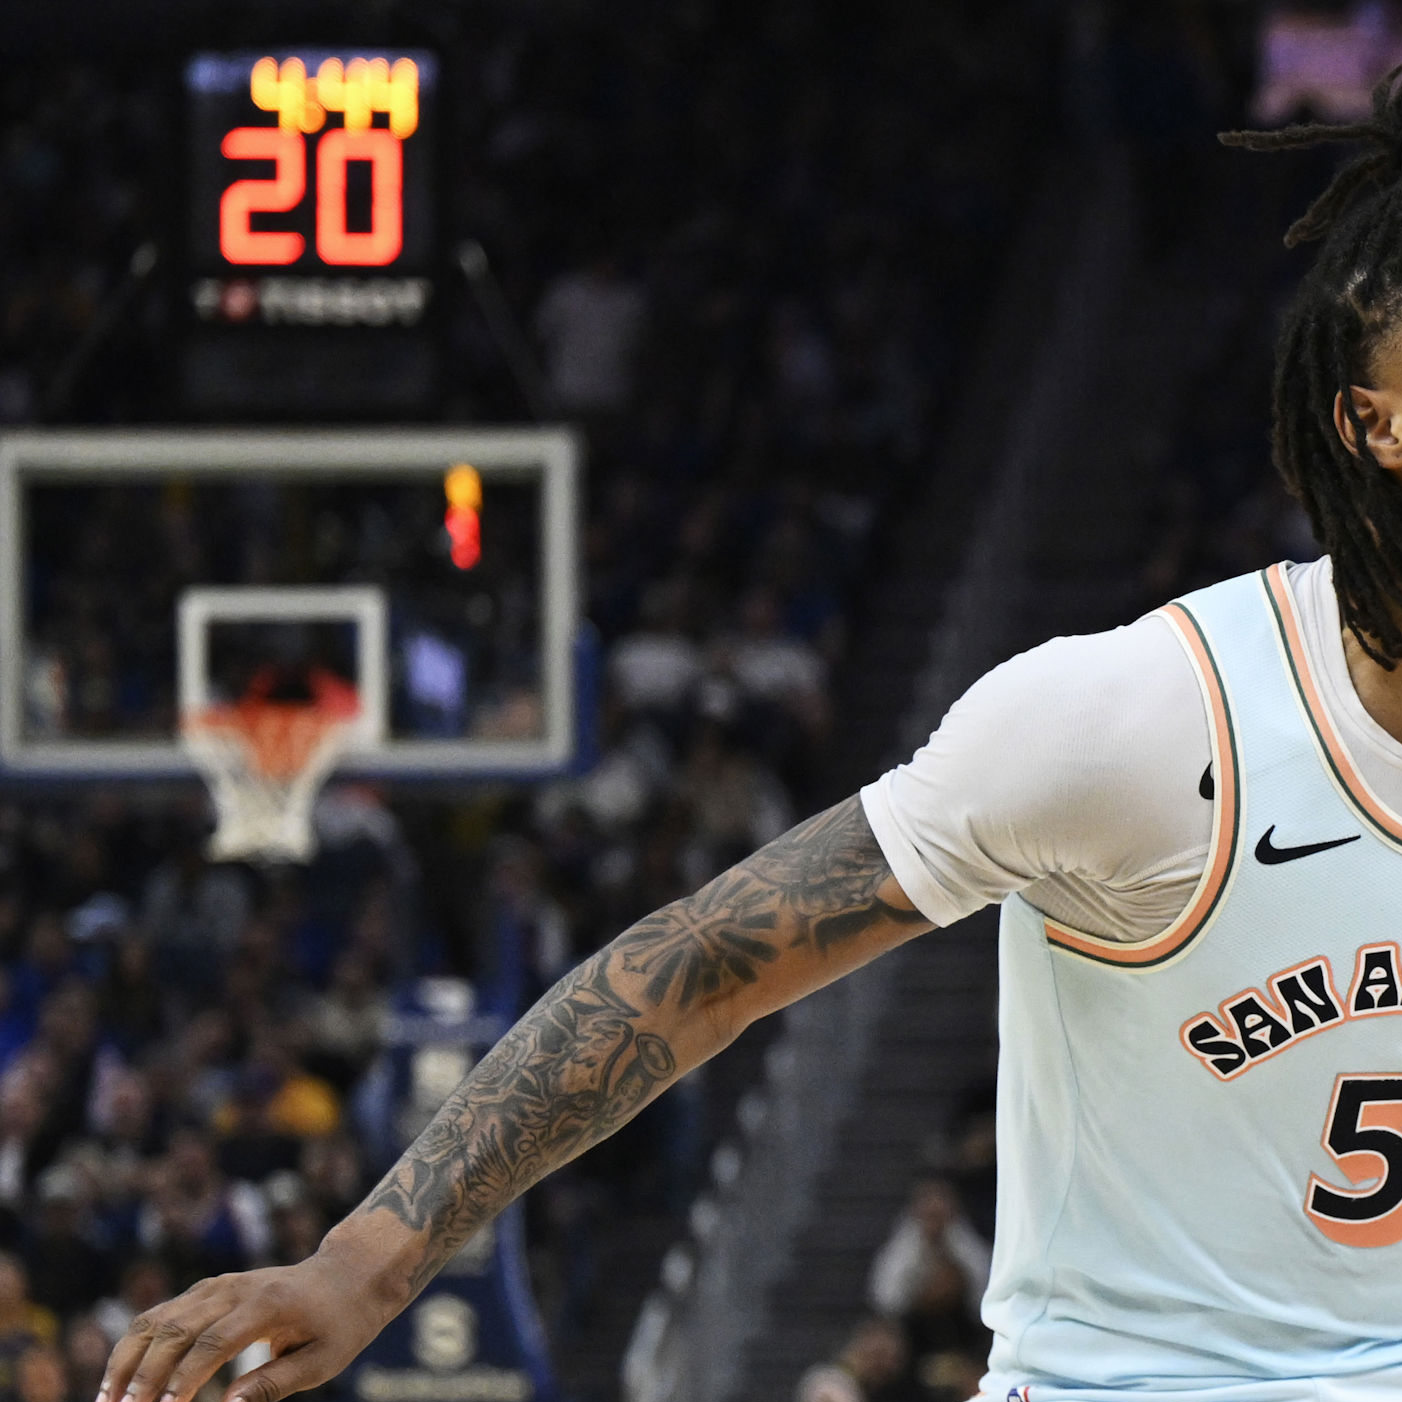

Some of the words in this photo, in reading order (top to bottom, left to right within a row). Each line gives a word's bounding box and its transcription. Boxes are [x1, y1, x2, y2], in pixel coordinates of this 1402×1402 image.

[251, 56, 419, 140] 4:44
[220, 127, 403, 266] 20
[1180, 957, 1344, 1082] SAN
